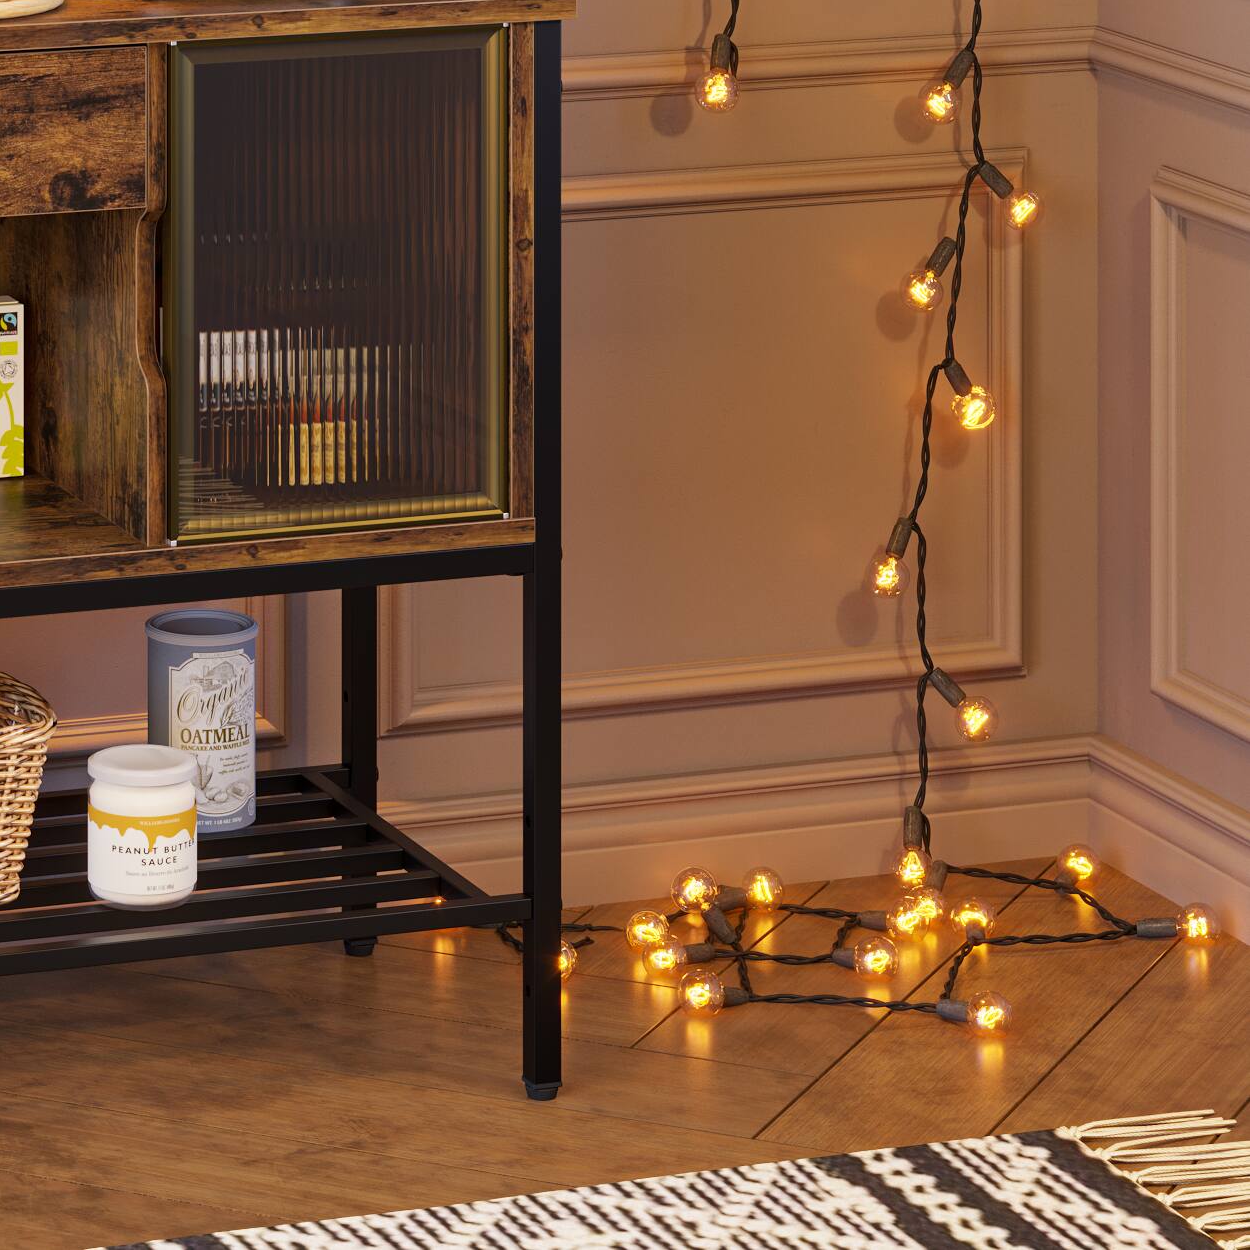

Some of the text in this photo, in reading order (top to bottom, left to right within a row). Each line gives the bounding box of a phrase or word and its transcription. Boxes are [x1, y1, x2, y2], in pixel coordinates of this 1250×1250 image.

[177, 667, 248, 726] Organic
[181, 723, 250, 744] OATMEAL
[112, 845, 158, 854] PEANUT
[141, 856, 178, 866] SAUCE
